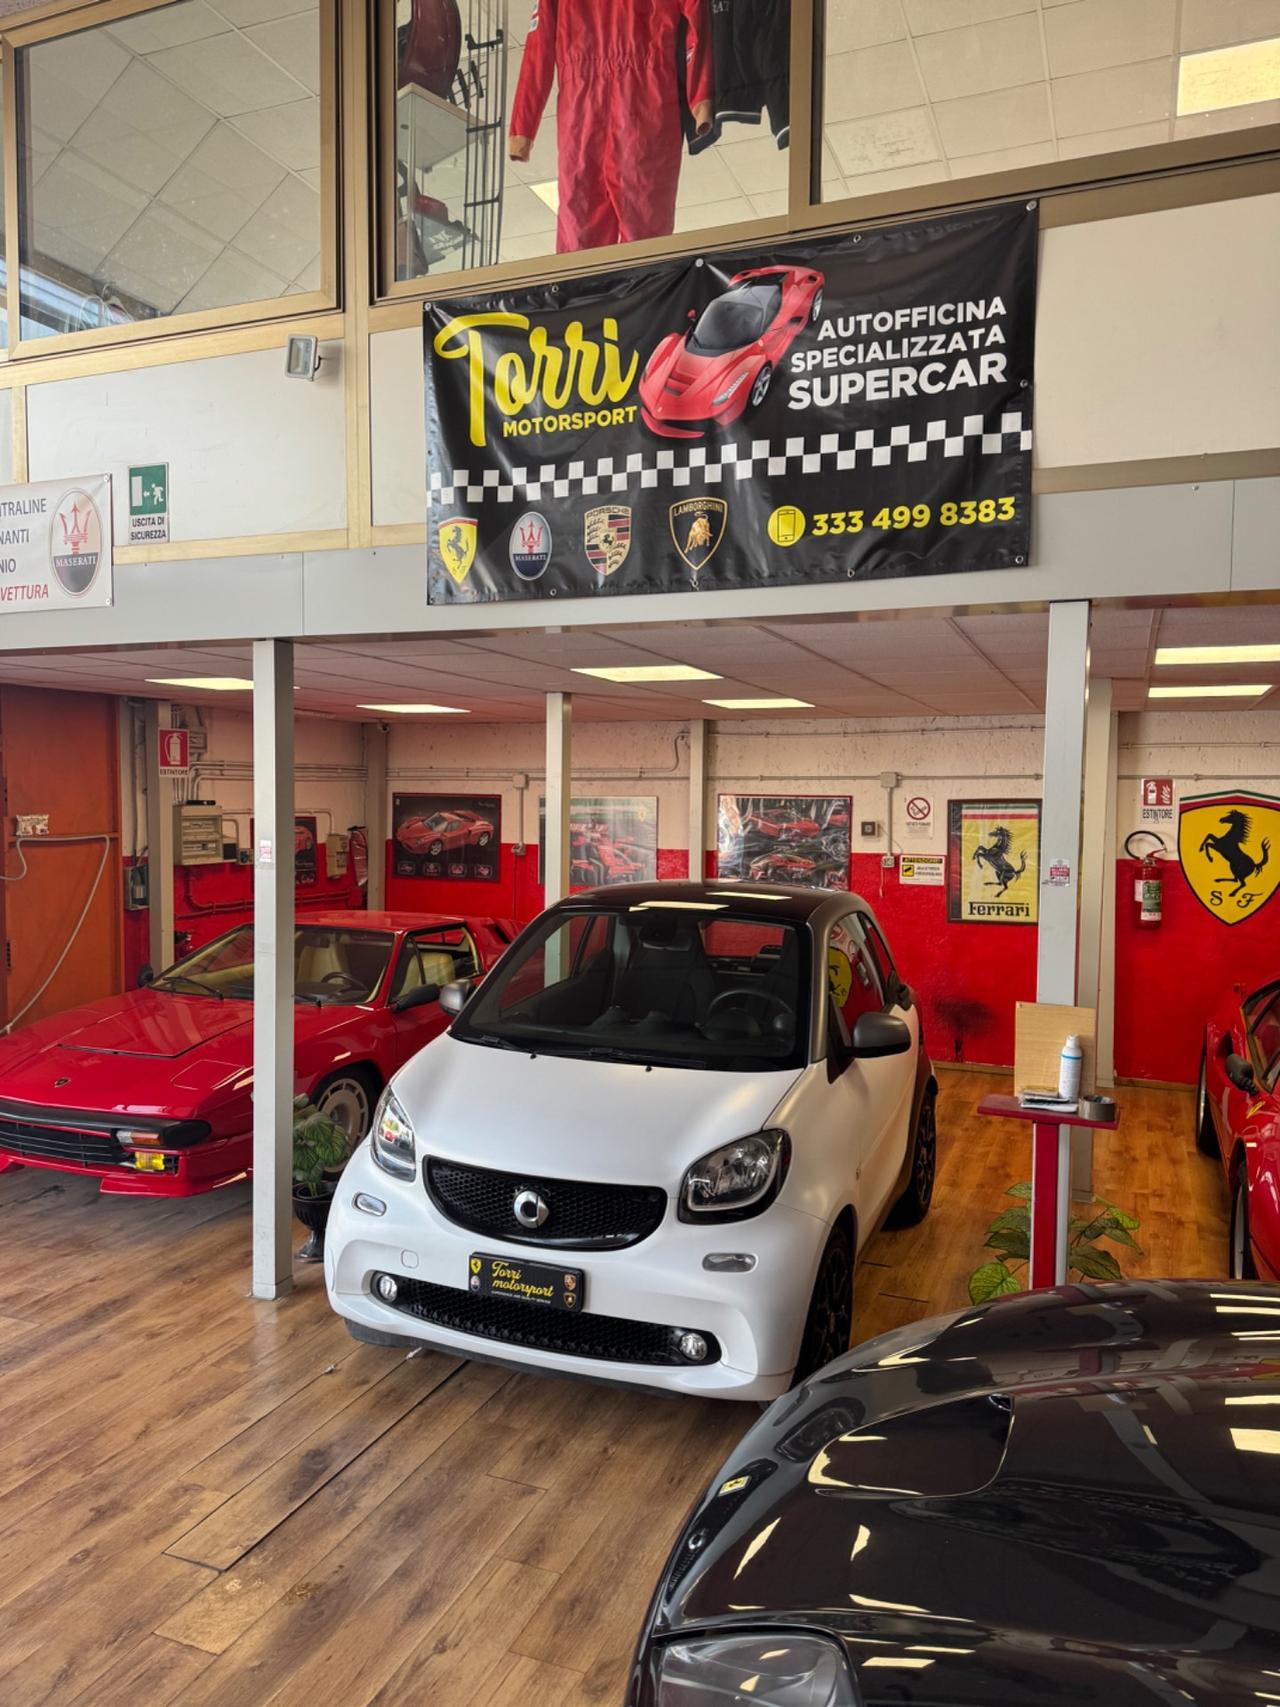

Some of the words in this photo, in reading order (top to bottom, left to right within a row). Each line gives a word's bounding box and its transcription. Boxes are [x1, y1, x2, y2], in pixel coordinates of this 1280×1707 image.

[817, 296, 1007, 341] AUTOFFICINA
[790, 324, 1006, 373] SPECIALIZZATA
[434, 312, 639, 447] Torri
[788, 352, 1007, 410] SUPERCAR
[503, 405, 638, 438] MOTORSPORT
[0, 499, 47, 517] TRALINE
[812, 511, 865, 536] 333
[872, 504, 931, 530] 499
[939, 496, 1016, 526] 8383
[132, 517, 156, 527] USCITA
[157, 516, 165, 526] DI
[131, 530, 166, 541] SICUREZZA
[55, 555, 97, 568] MASERATI
[0, 584, 49, 601] VETTURA
[1142, 808, 1173, 819] ESTINTORE
[1210, 890, 1223, 906] S
[968, 901, 1030, 917] Ferrari
[492, 1260, 522, 1280] Torri
[492, 1279, 554, 1297] motorsport
